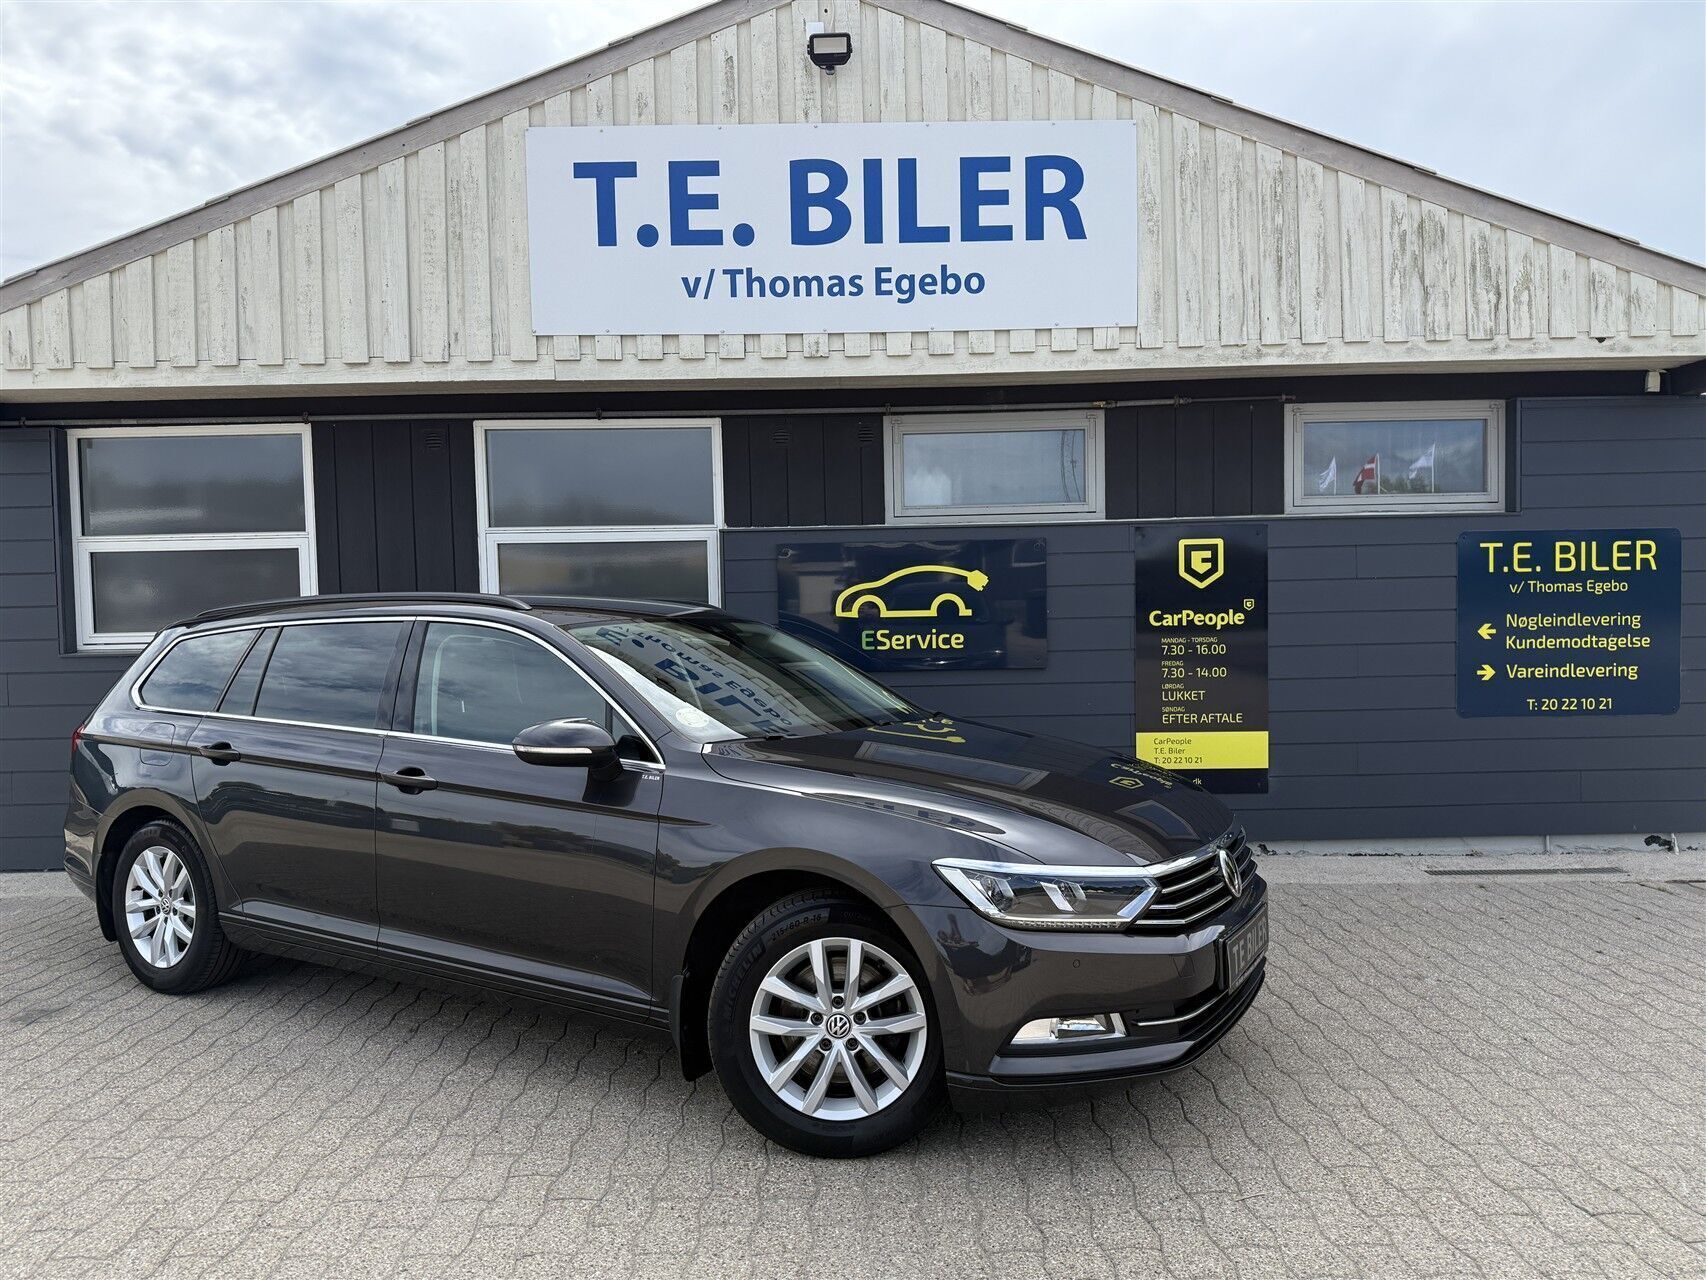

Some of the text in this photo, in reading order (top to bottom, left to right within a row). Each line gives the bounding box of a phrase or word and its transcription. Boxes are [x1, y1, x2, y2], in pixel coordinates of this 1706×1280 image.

[573, 155, 1087, 247] T.E. BILER
[681, 264, 985, 304] v/ Thomas Egebo
[1480, 540, 1656, 572] T.E. BILER
[1510, 580, 1628, 594] v/ Thomas Egebo
[1149, 608, 1245, 630] CarPeople
[1507, 612, 1641, 630] Nøgleindlevering
[862, 629, 964, 650] EService
[1507, 634, 1650, 651] Kundemodtagelse
[1162, 645, 1184, 655] 7.30
[1196, 644, 1226, 654] 16.00
[1162, 668, 1184, 678] 7.30
[1196, 667, 1226, 677] 14.00
[1507, 663, 1638, 680] Vareindlevering
[1163, 691, 1205, 701] LUKKET
[1527, 698, 1611, 710] T: 20 22 10 21
[1163, 713, 1242, 723] EFTER AFTALE
[1154, 737, 1193, 746] CarPeople
[1154, 756, 1160, 764] T:
